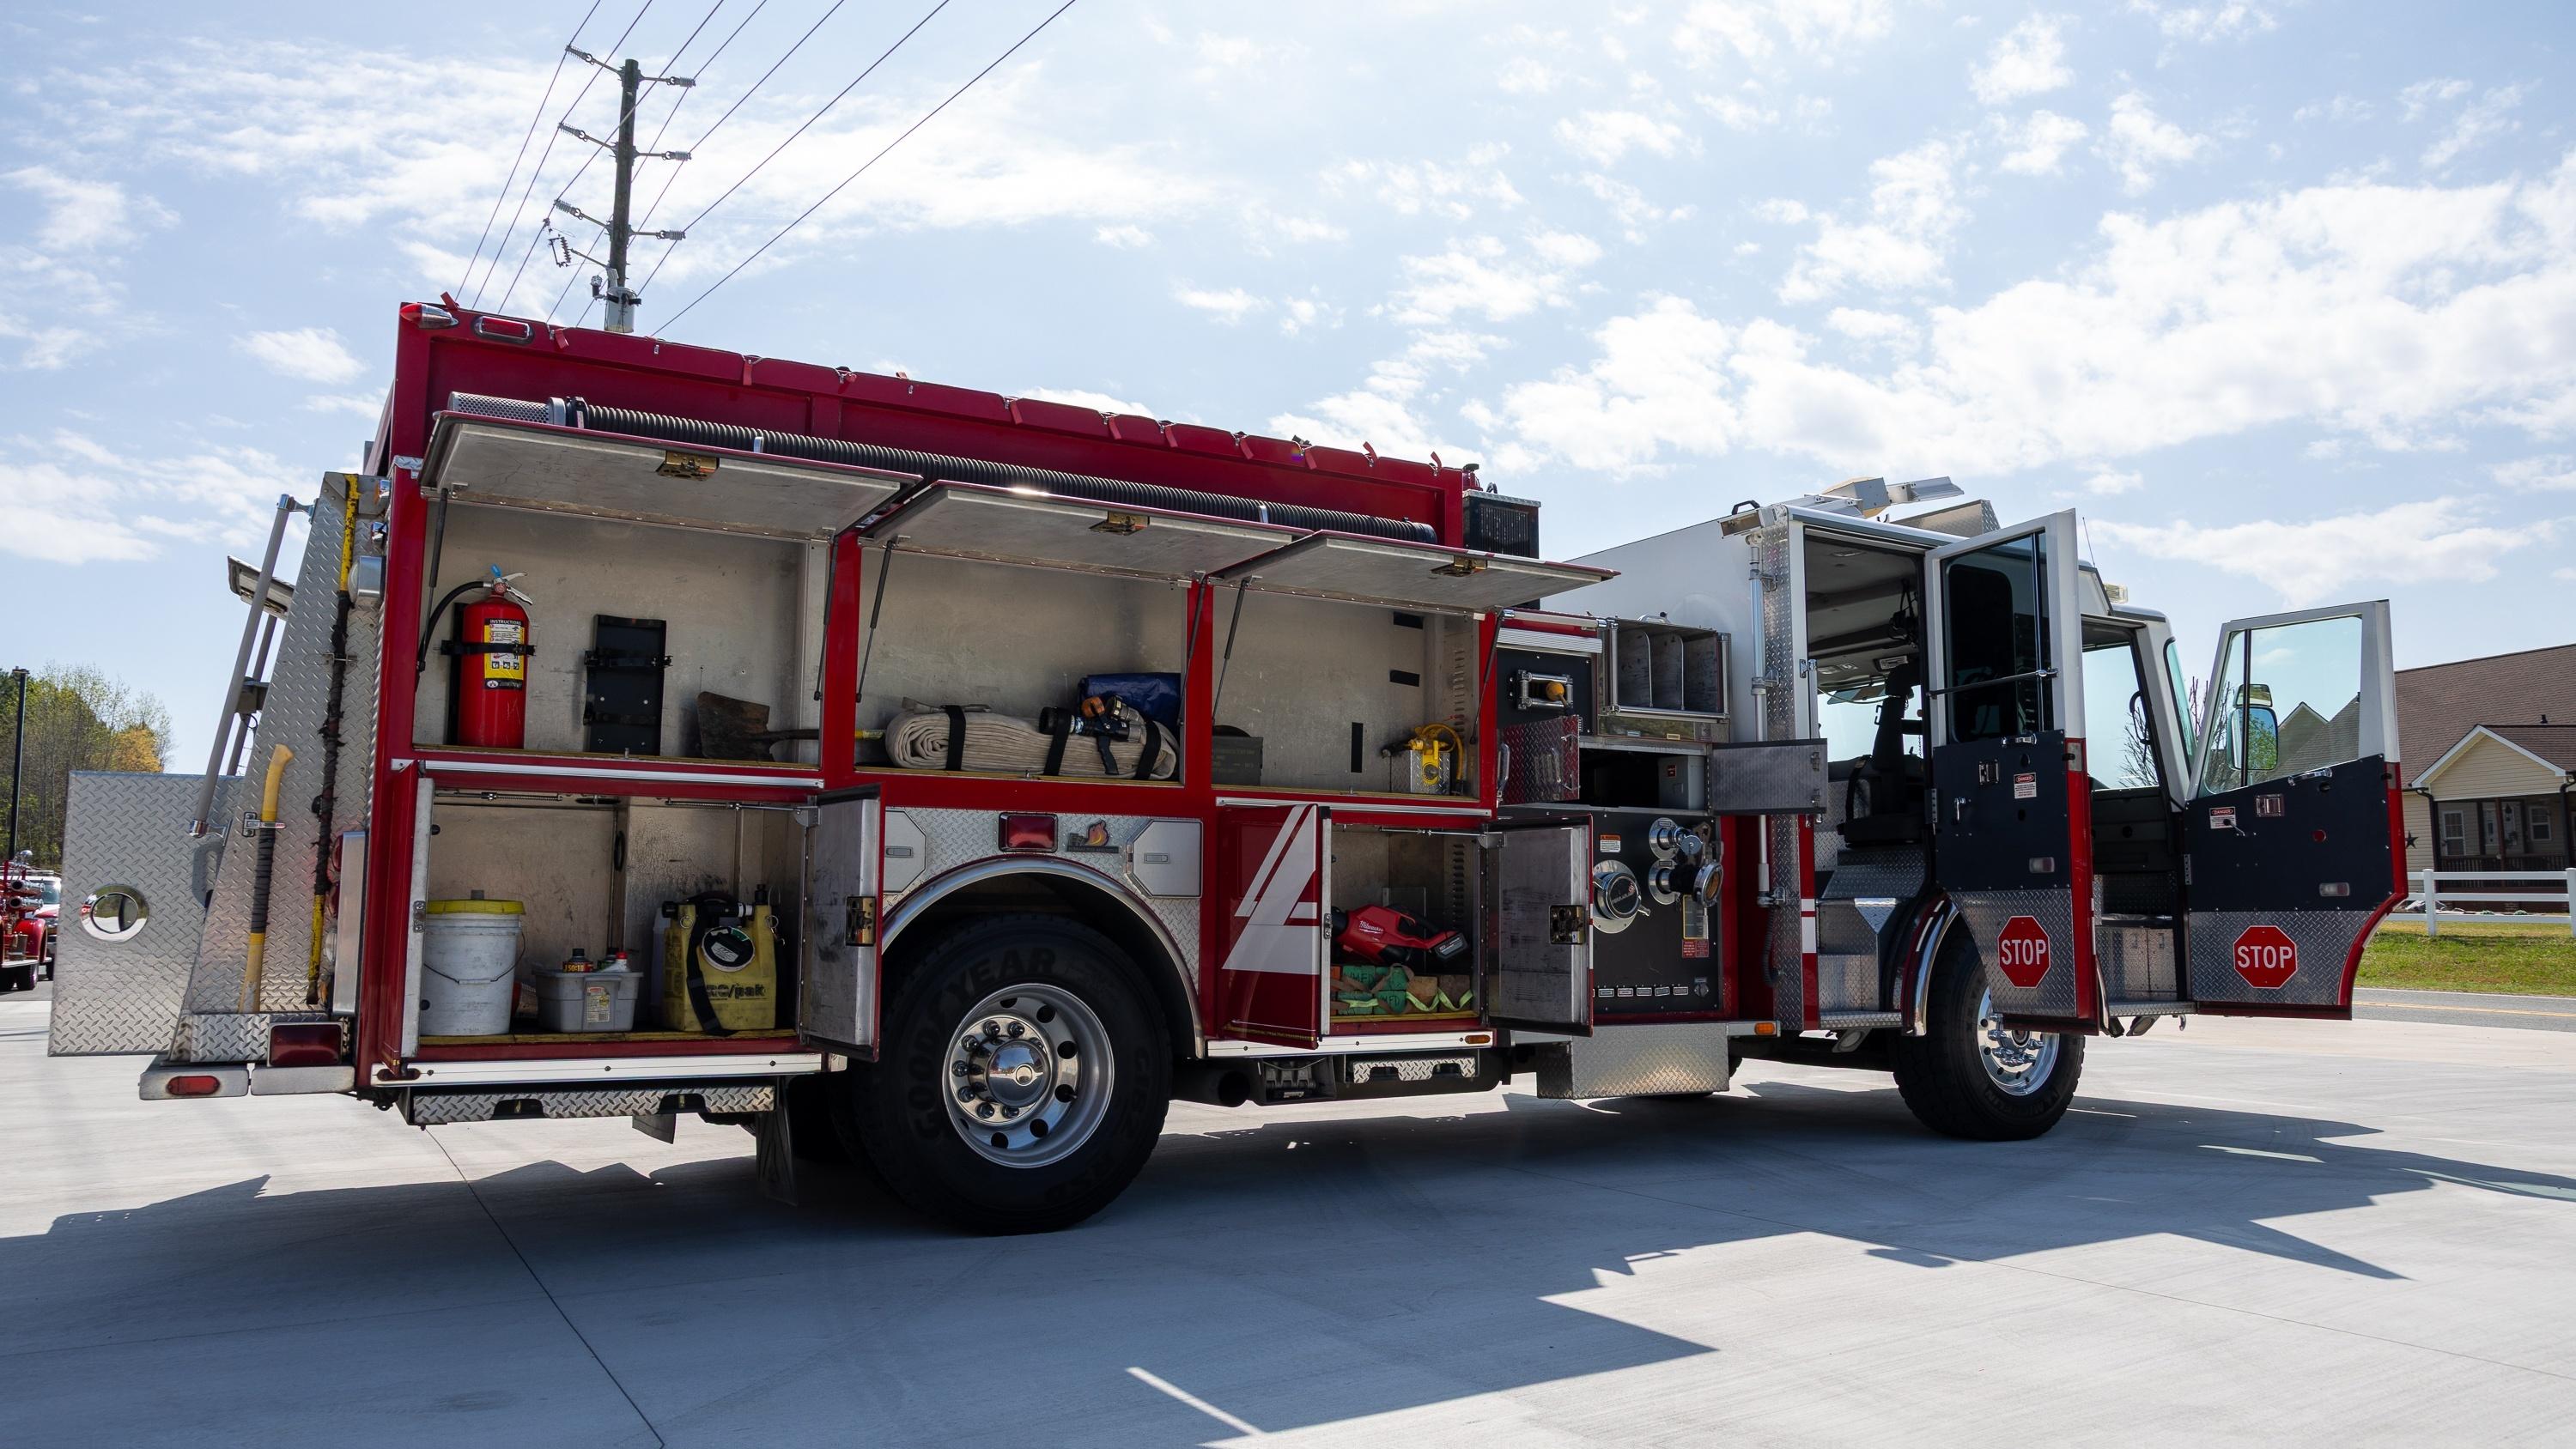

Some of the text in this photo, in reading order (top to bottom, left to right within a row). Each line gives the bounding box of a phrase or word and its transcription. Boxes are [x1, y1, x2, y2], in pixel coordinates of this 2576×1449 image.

[1359, 920, 1383, 932] Milwaukee
[2001, 939, 2046, 965] STOP
[2237, 945, 2293, 968] STOP
